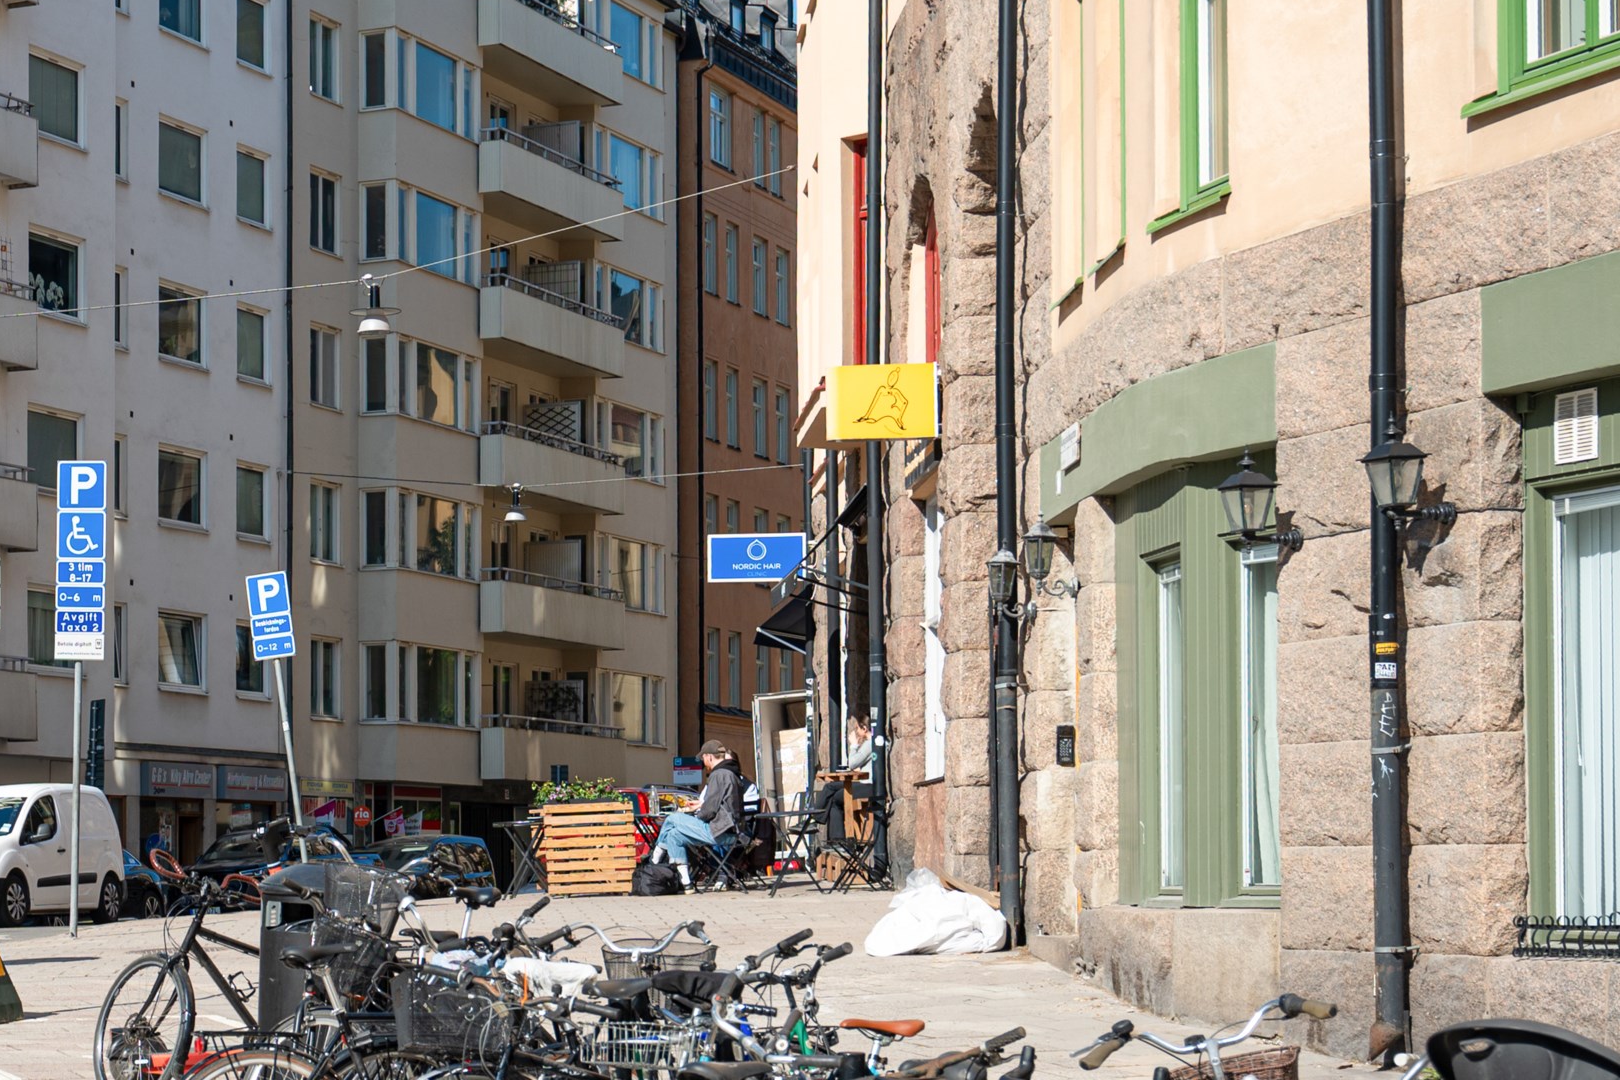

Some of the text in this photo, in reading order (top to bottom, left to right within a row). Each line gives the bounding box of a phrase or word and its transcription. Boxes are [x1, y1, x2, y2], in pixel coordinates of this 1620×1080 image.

[71, 466, 97, 505] P
[68, 562, 93, 572] 3 tim
[69, 573, 92, 582] 8-17
[92, 594, 101, 602] m
[257, 578, 280, 612] P
[63, 612, 97, 623] Avgift
[61, 623, 99, 632] Taxa 2
[257, 643, 278, 652] 0-12
[354, 808, 370, 819] ria
